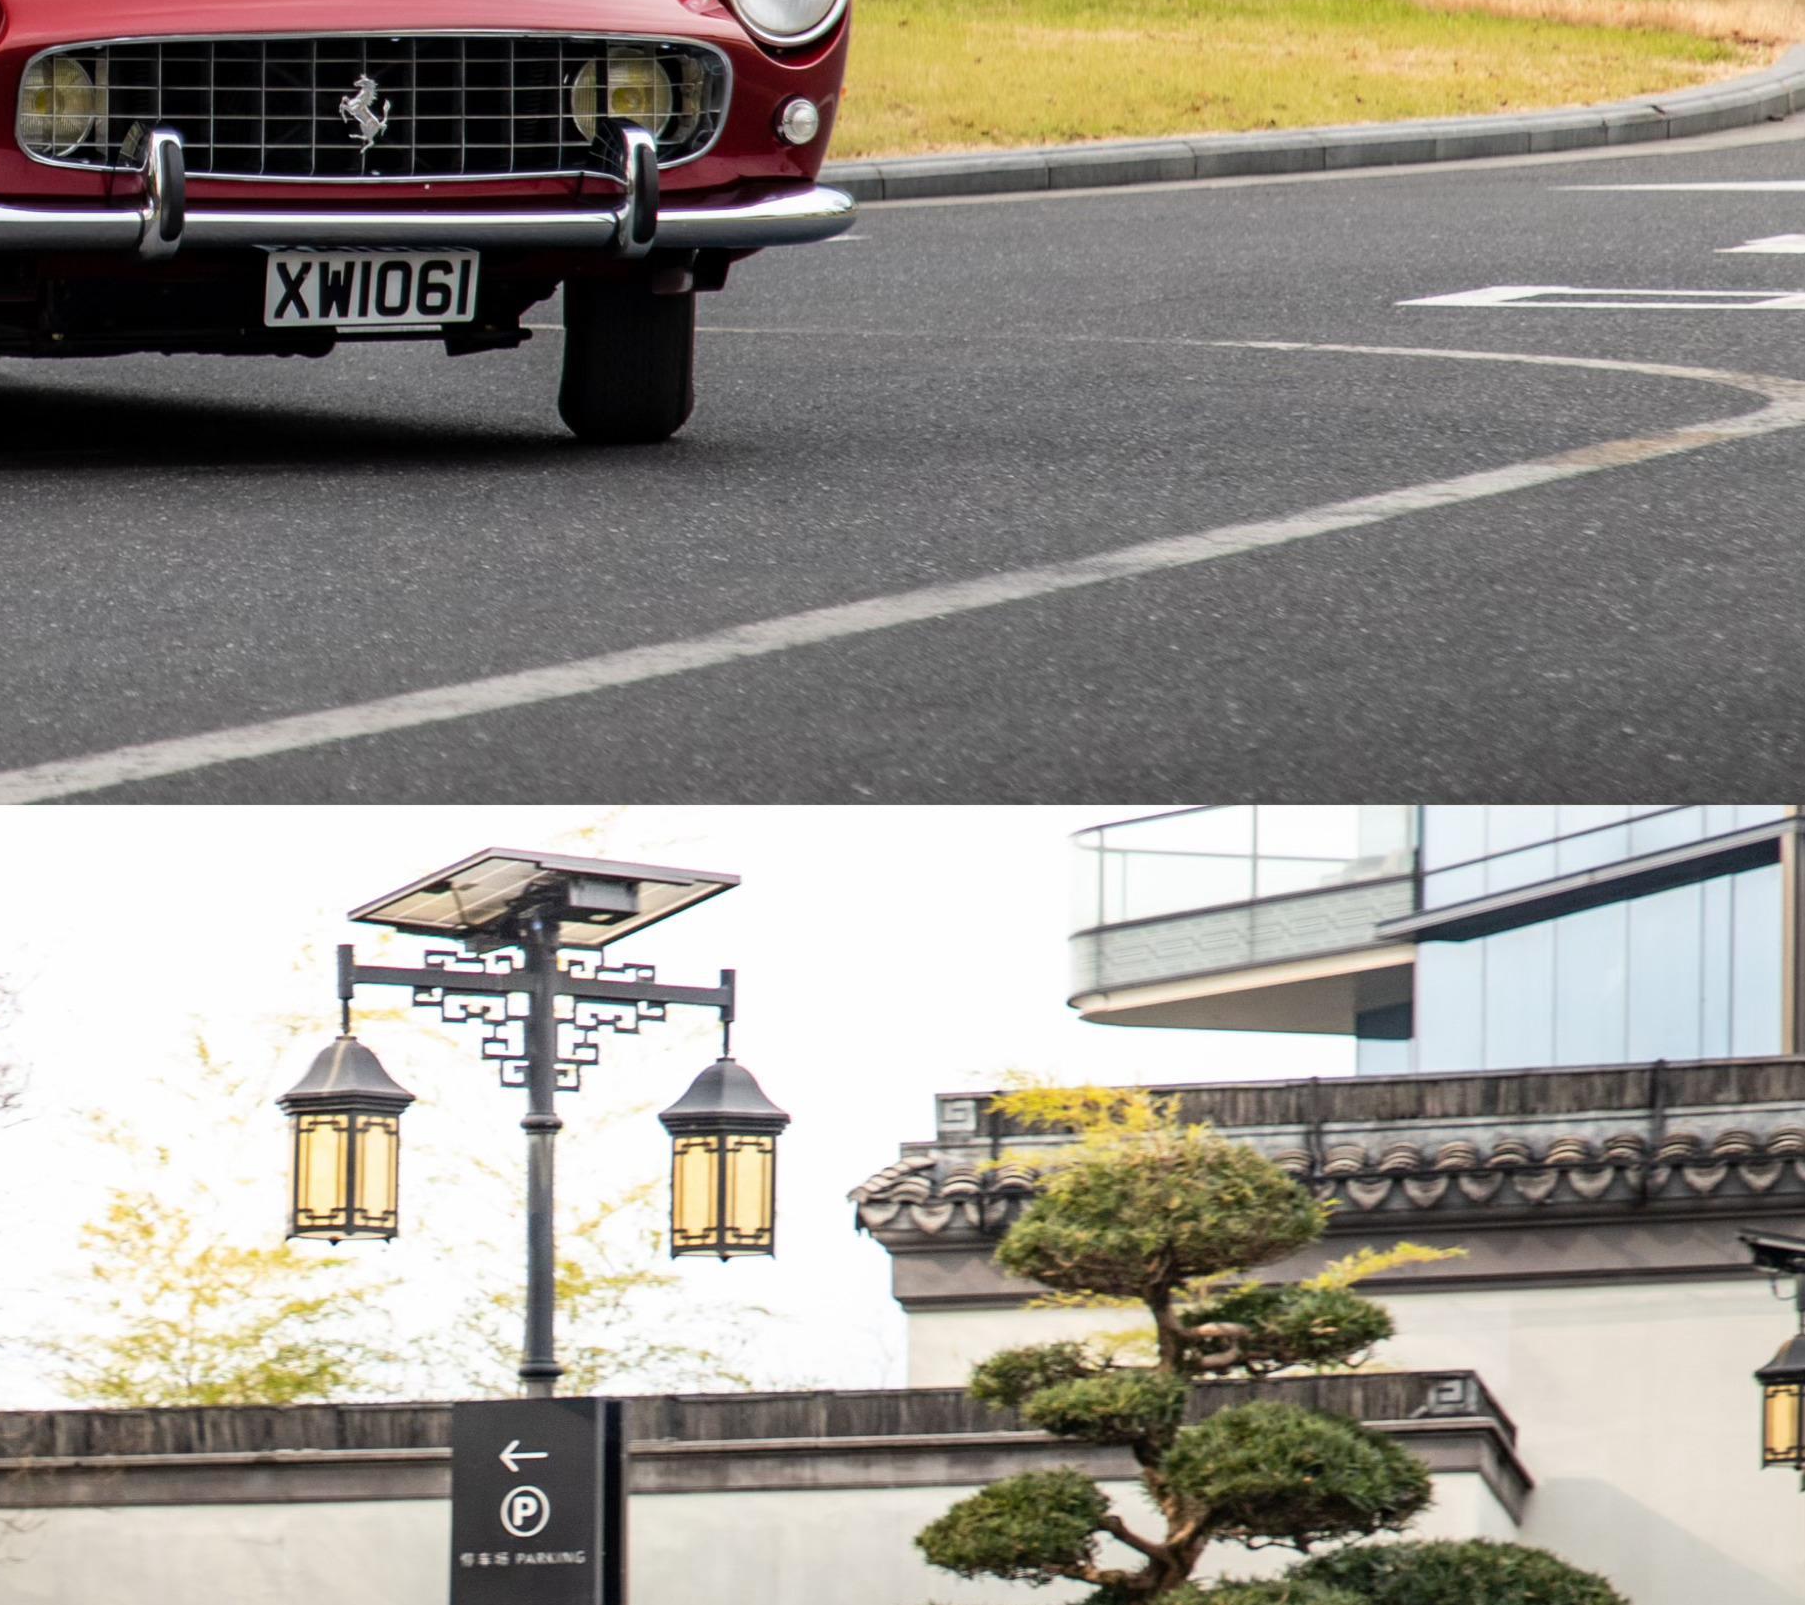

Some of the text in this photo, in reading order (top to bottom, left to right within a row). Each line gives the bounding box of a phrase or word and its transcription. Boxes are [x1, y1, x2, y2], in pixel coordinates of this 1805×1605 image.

[273, 259, 472, 319] XW1061
[512, 1495, 538, 1527] P
[515, 1550, 587, 1565] PARKING
